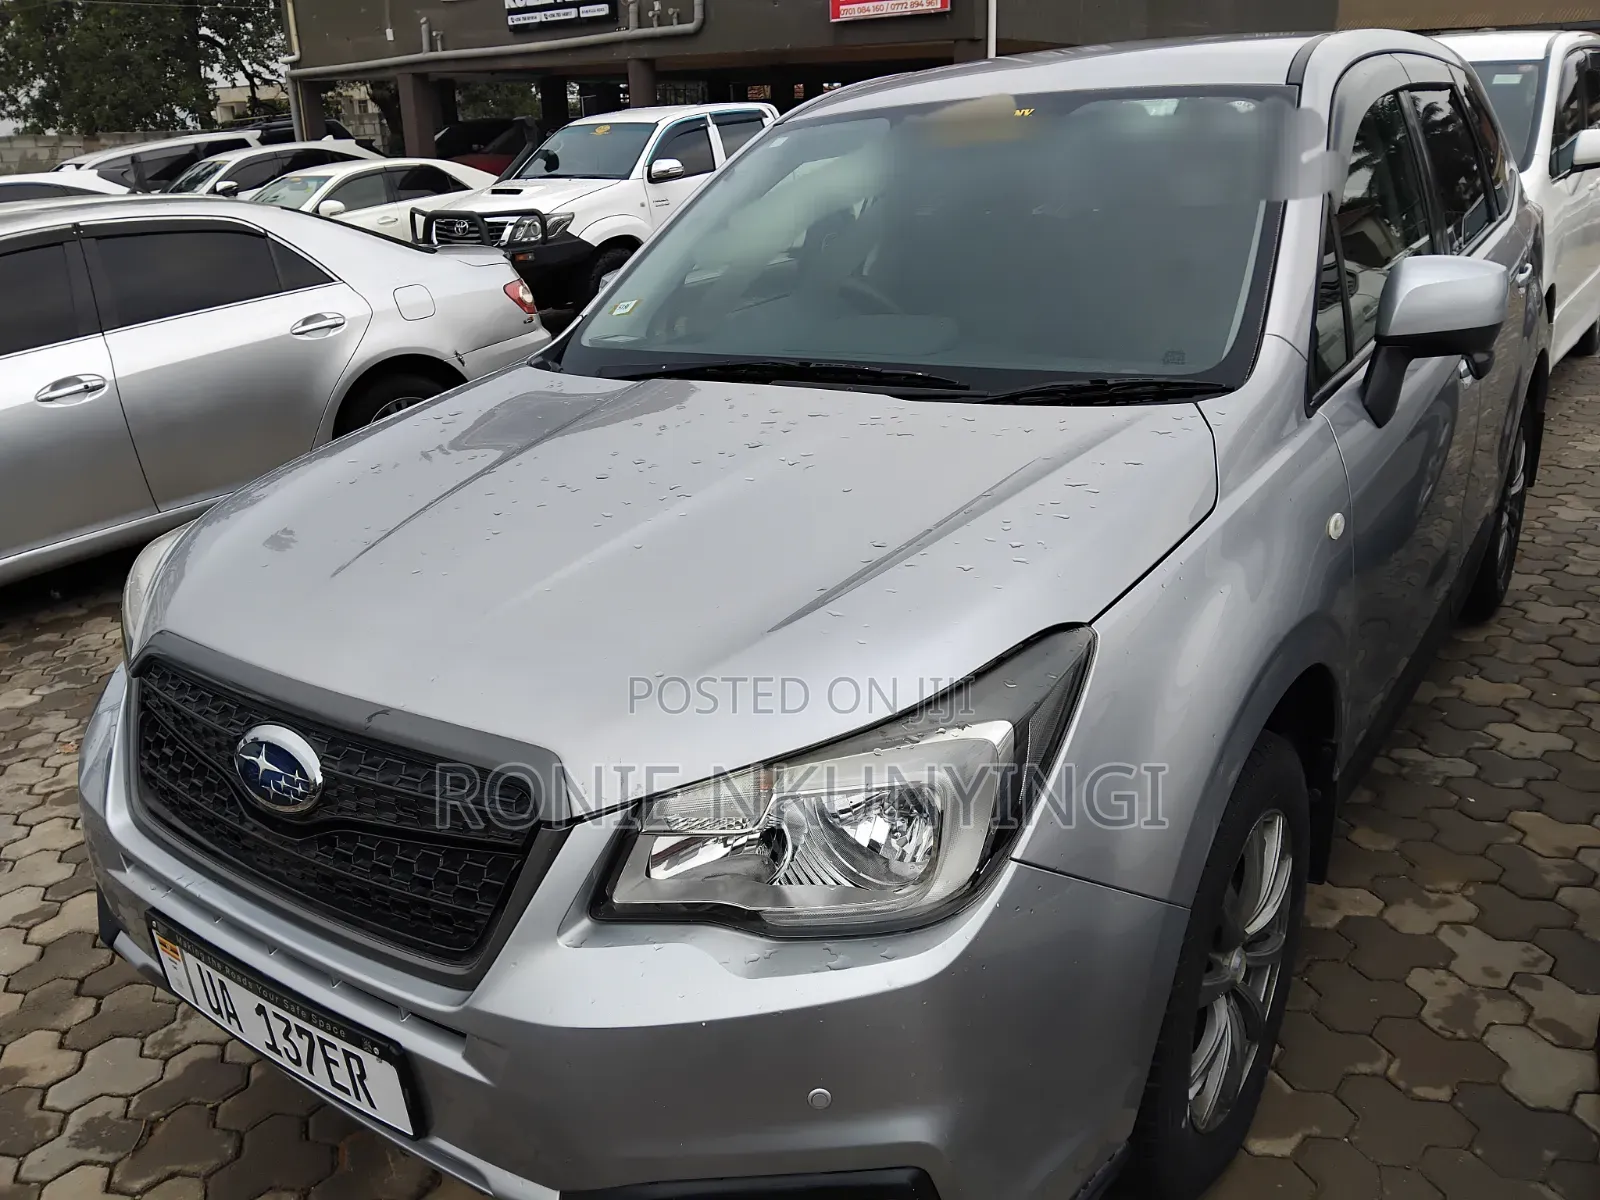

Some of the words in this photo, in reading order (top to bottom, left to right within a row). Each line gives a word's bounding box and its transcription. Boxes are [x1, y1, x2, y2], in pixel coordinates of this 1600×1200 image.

[840, 8, 856, 16] 0701
[857, 6, 871, 14] 084
[891, 1, 908, 10] 0772
[910, 0, 924, 8] 894
[176, 934, 205, 962] Making
[207, 956, 222, 971] the
[224, 965, 253, 989] Roads
[256, 983, 279, 1002] Your
[283, 999, 307, 1018] Safe
[311, 1013, 346, 1038] Space
[196, 962, 245, 1033] UA
[254, 1002, 378, 1111] 137ER
